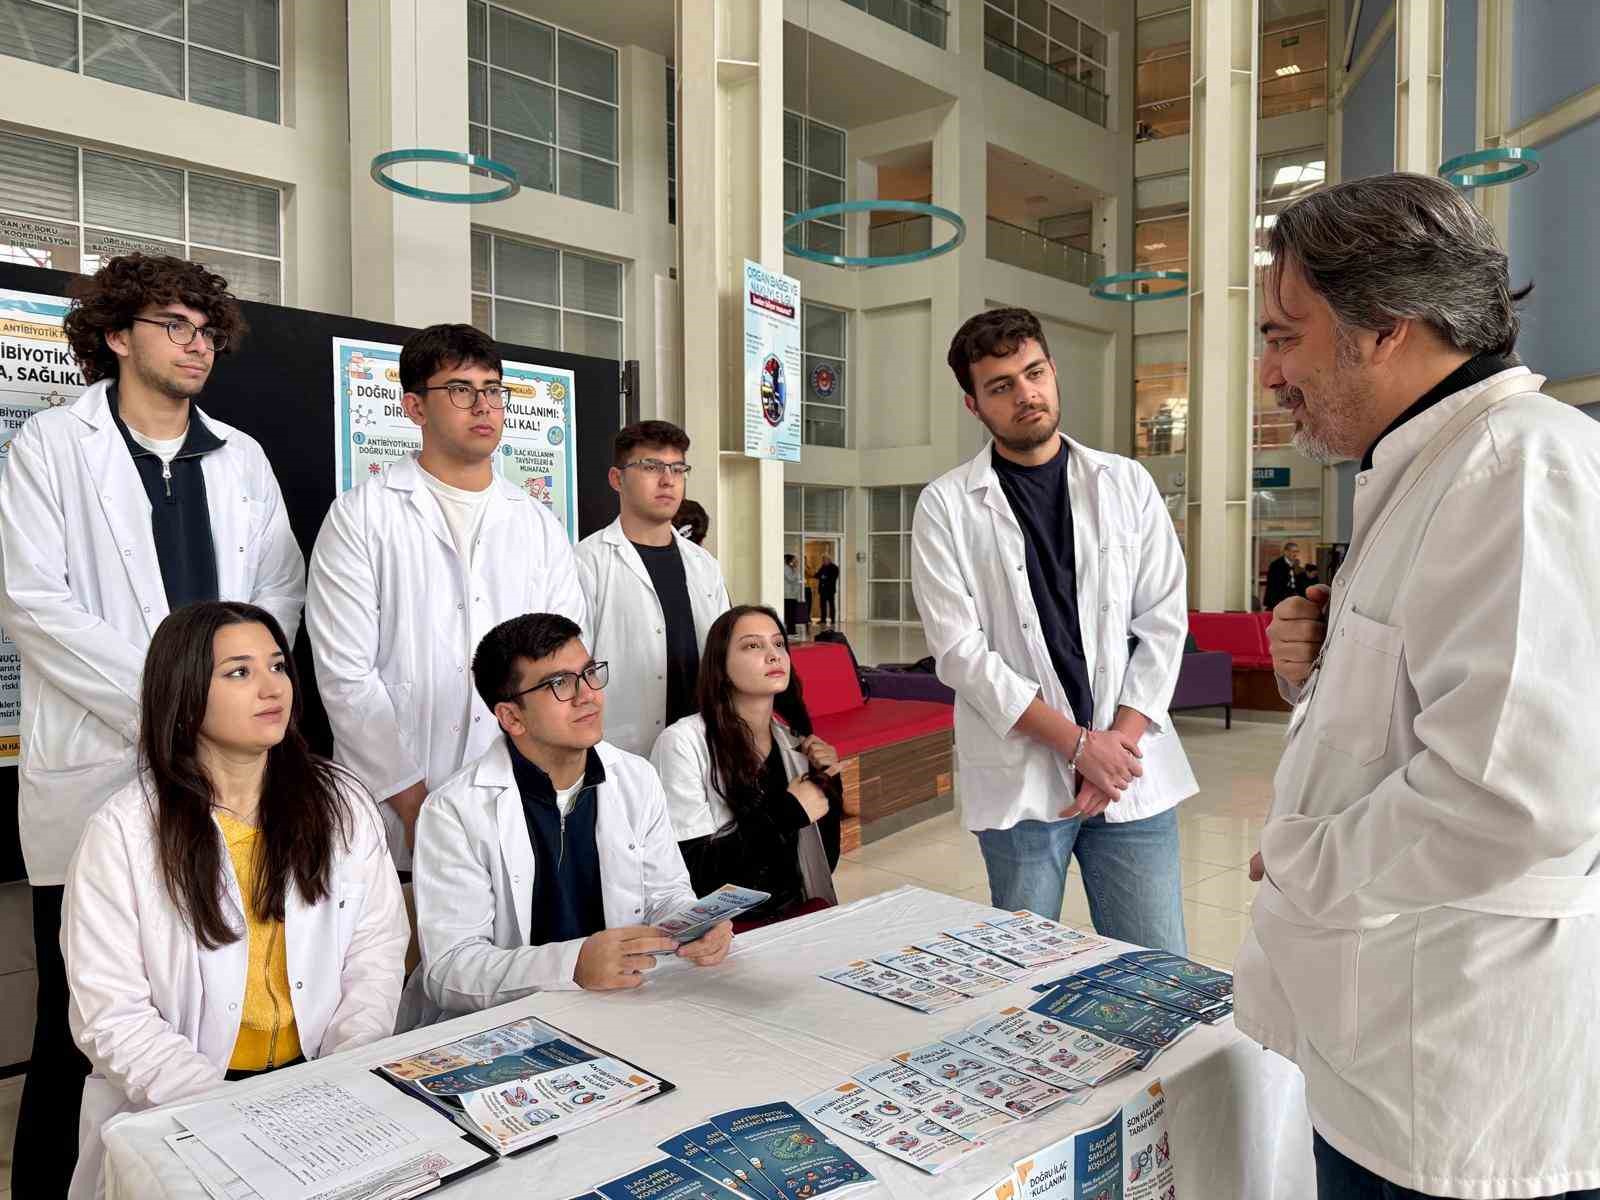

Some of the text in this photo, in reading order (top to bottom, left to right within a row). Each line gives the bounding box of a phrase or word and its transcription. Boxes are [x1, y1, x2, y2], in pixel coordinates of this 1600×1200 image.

[357, 384, 396, 401] DOĞRU
[384, 403, 408, 418] DİR
[506, 402, 559, 419] KULLANIMI:
[519, 419, 541, 432] KAL!
[359, 446, 383, 456] DOĞRU
[1127, 1114, 1140, 1128] SON
[1030, 1169, 1053, 1188] DOĞRU
[1032, 1172, 1067, 1197] KULLANIMI
